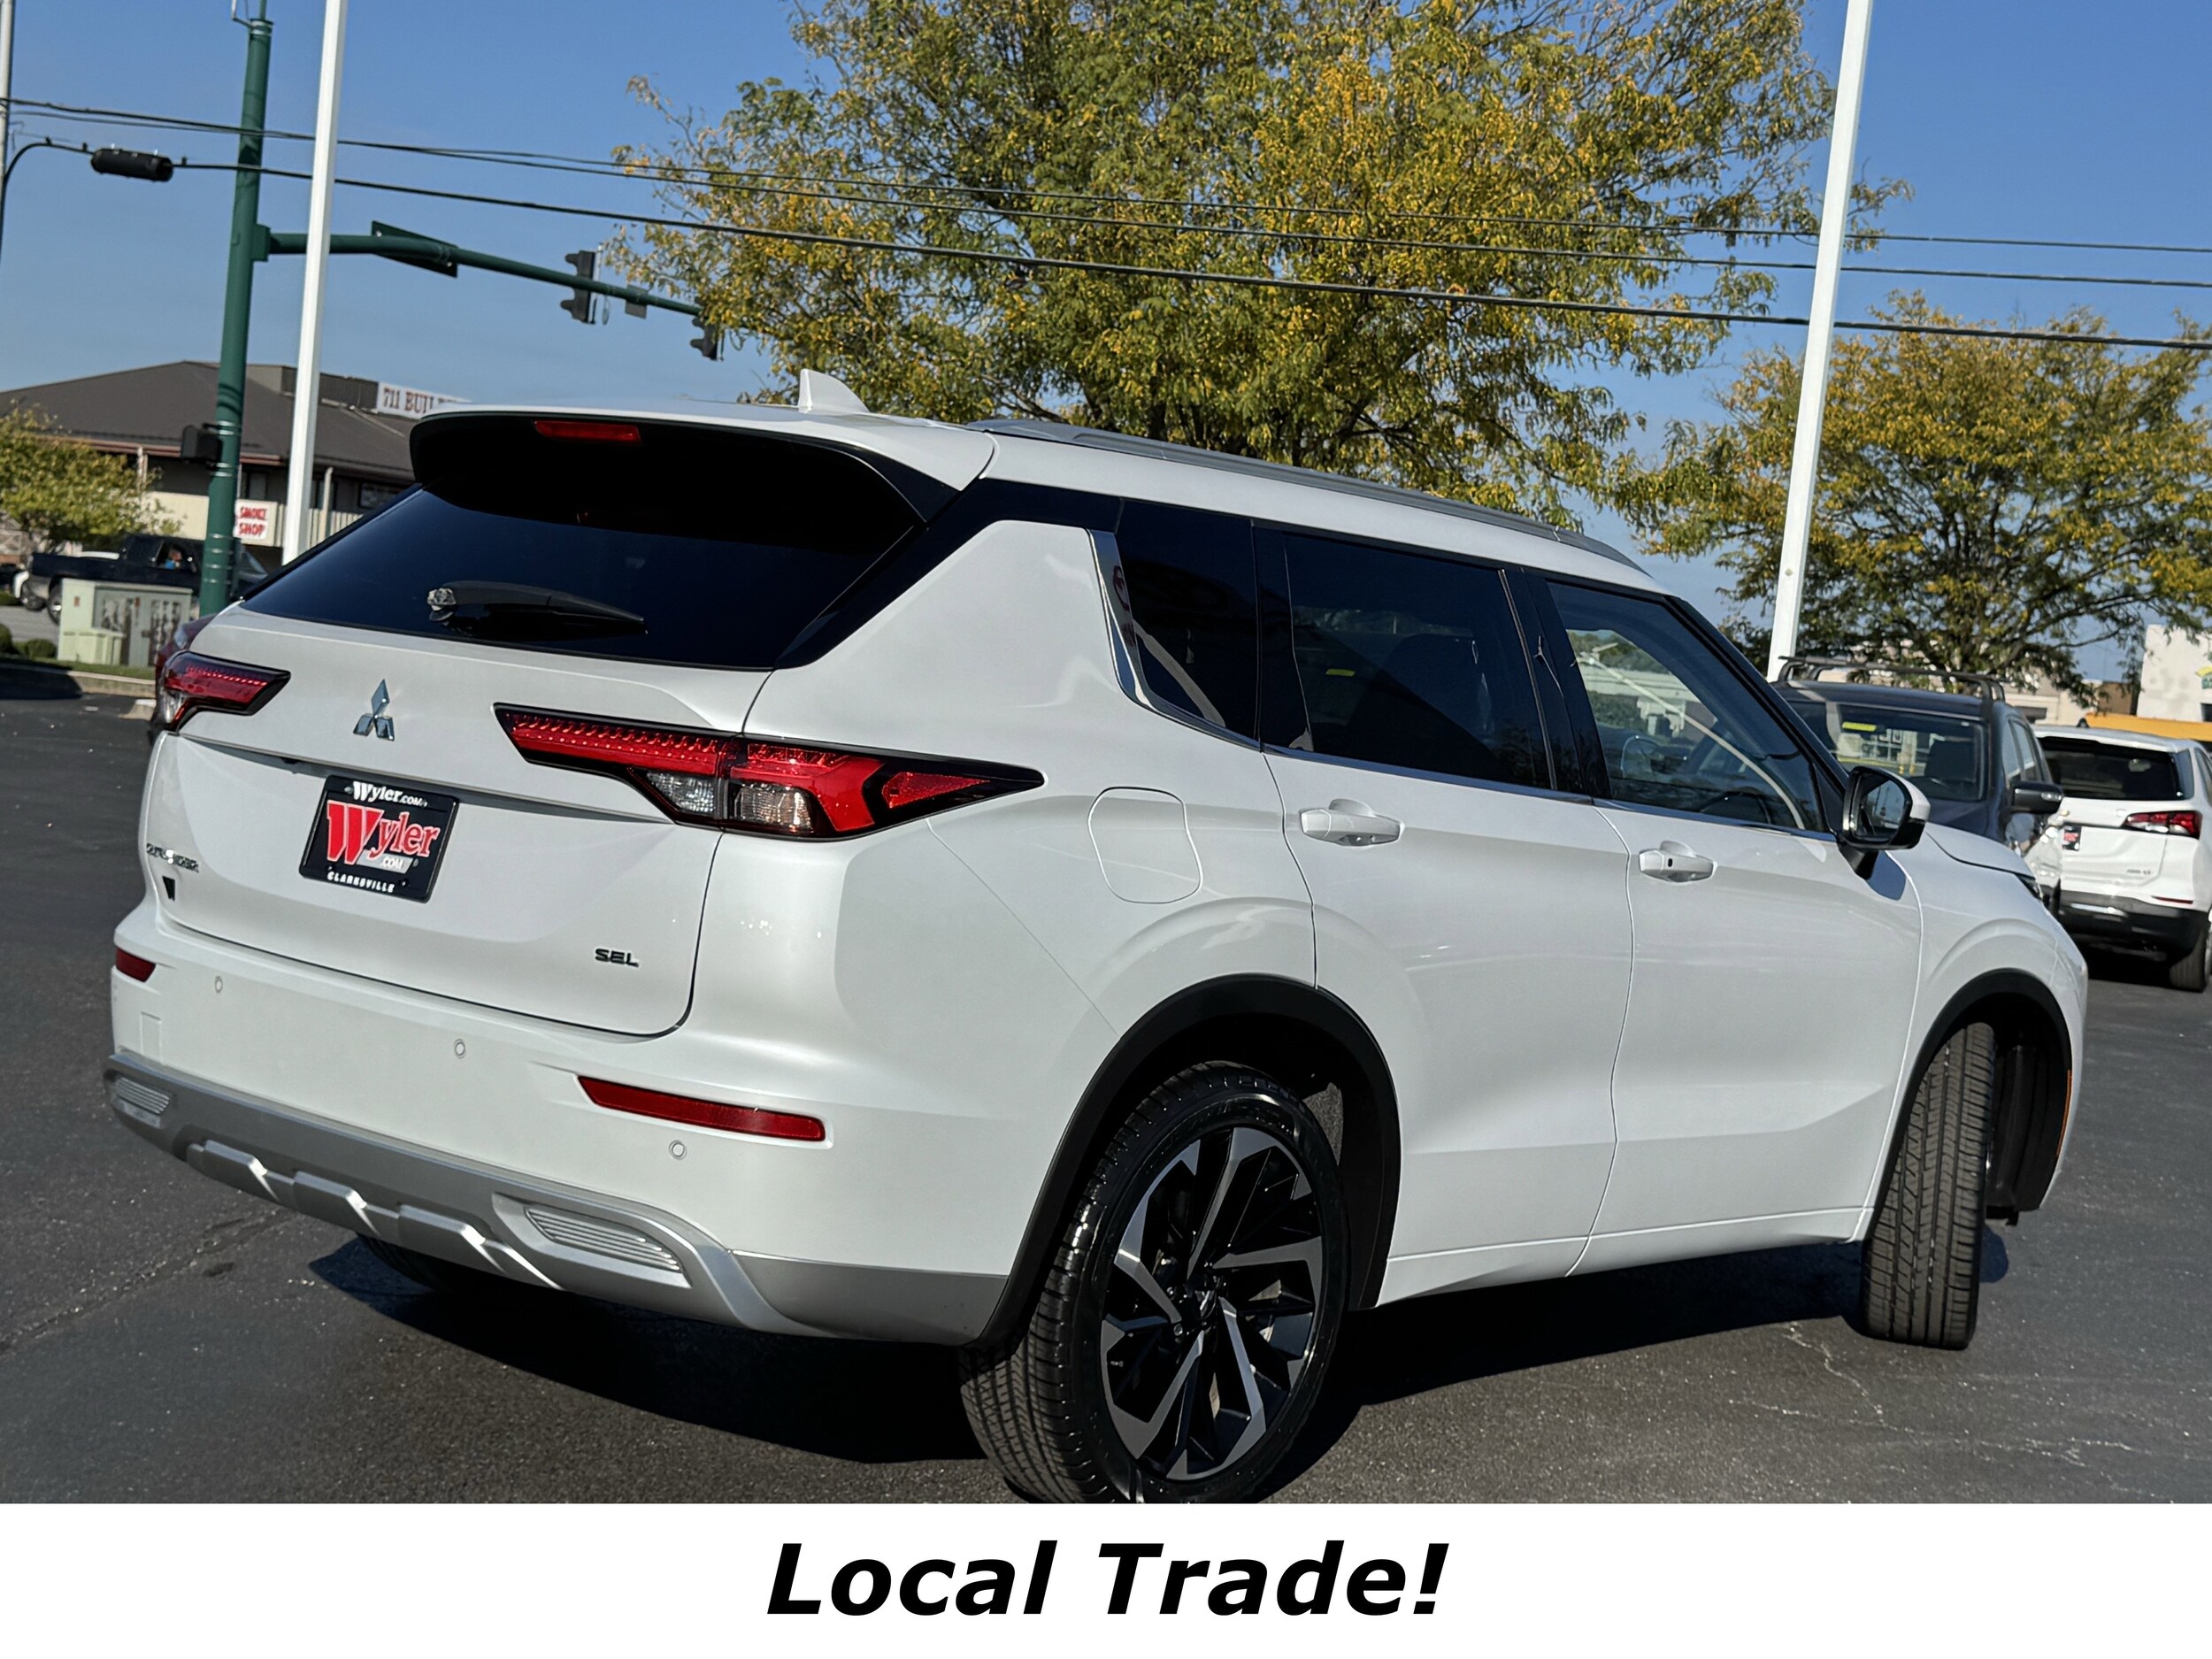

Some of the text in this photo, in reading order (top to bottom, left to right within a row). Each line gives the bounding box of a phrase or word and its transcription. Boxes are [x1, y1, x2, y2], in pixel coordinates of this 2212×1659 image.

[383, 388, 400, 409] 711
[239, 522, 265, 538] SHOP
[326, 799, 441, 865] Wyler
[326, 871, 396, 894] CLARKSVILLE
[595, 948, 640, 968] SEL
